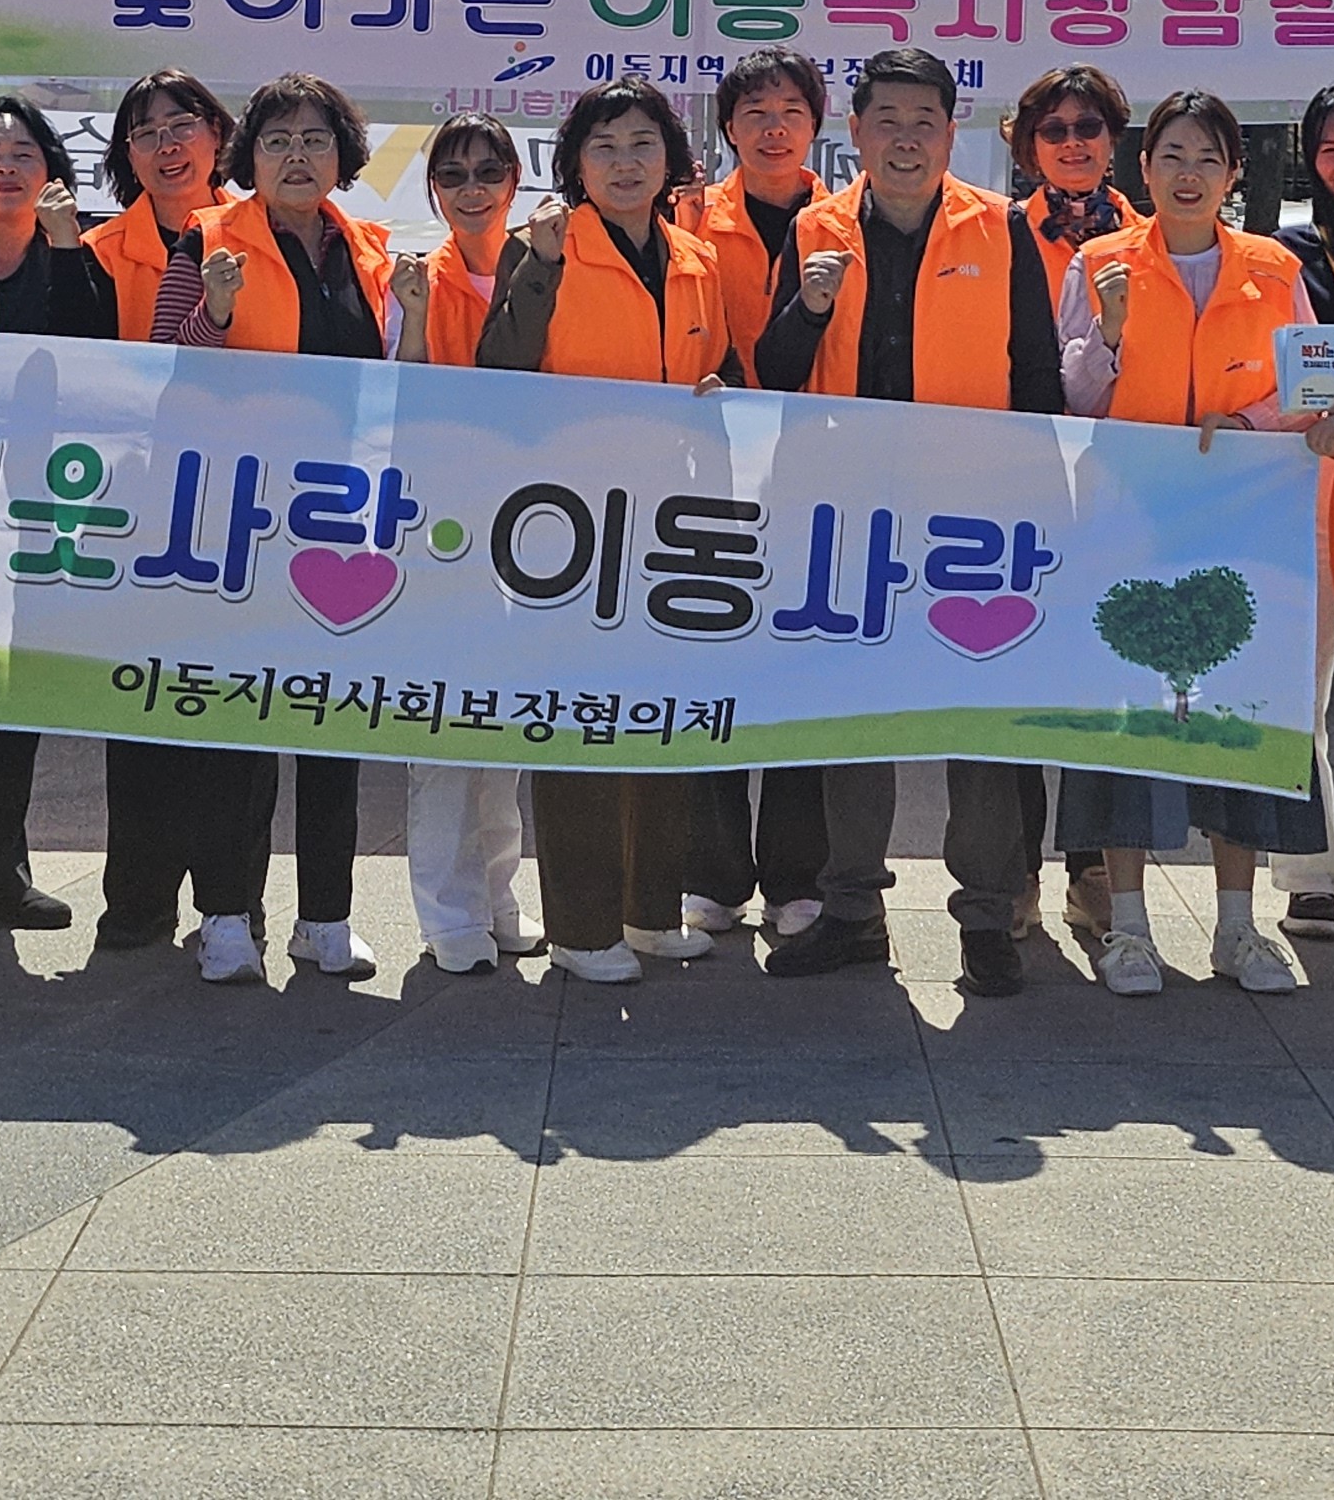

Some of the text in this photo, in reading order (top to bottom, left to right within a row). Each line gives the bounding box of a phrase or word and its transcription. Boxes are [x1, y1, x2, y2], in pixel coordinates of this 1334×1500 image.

[1301, 340, 1334, 359] 복지는
[490, 481, 1061, 661] 이동사랑
[111, 656, 737, 747] 이동지역사회보장협의체
